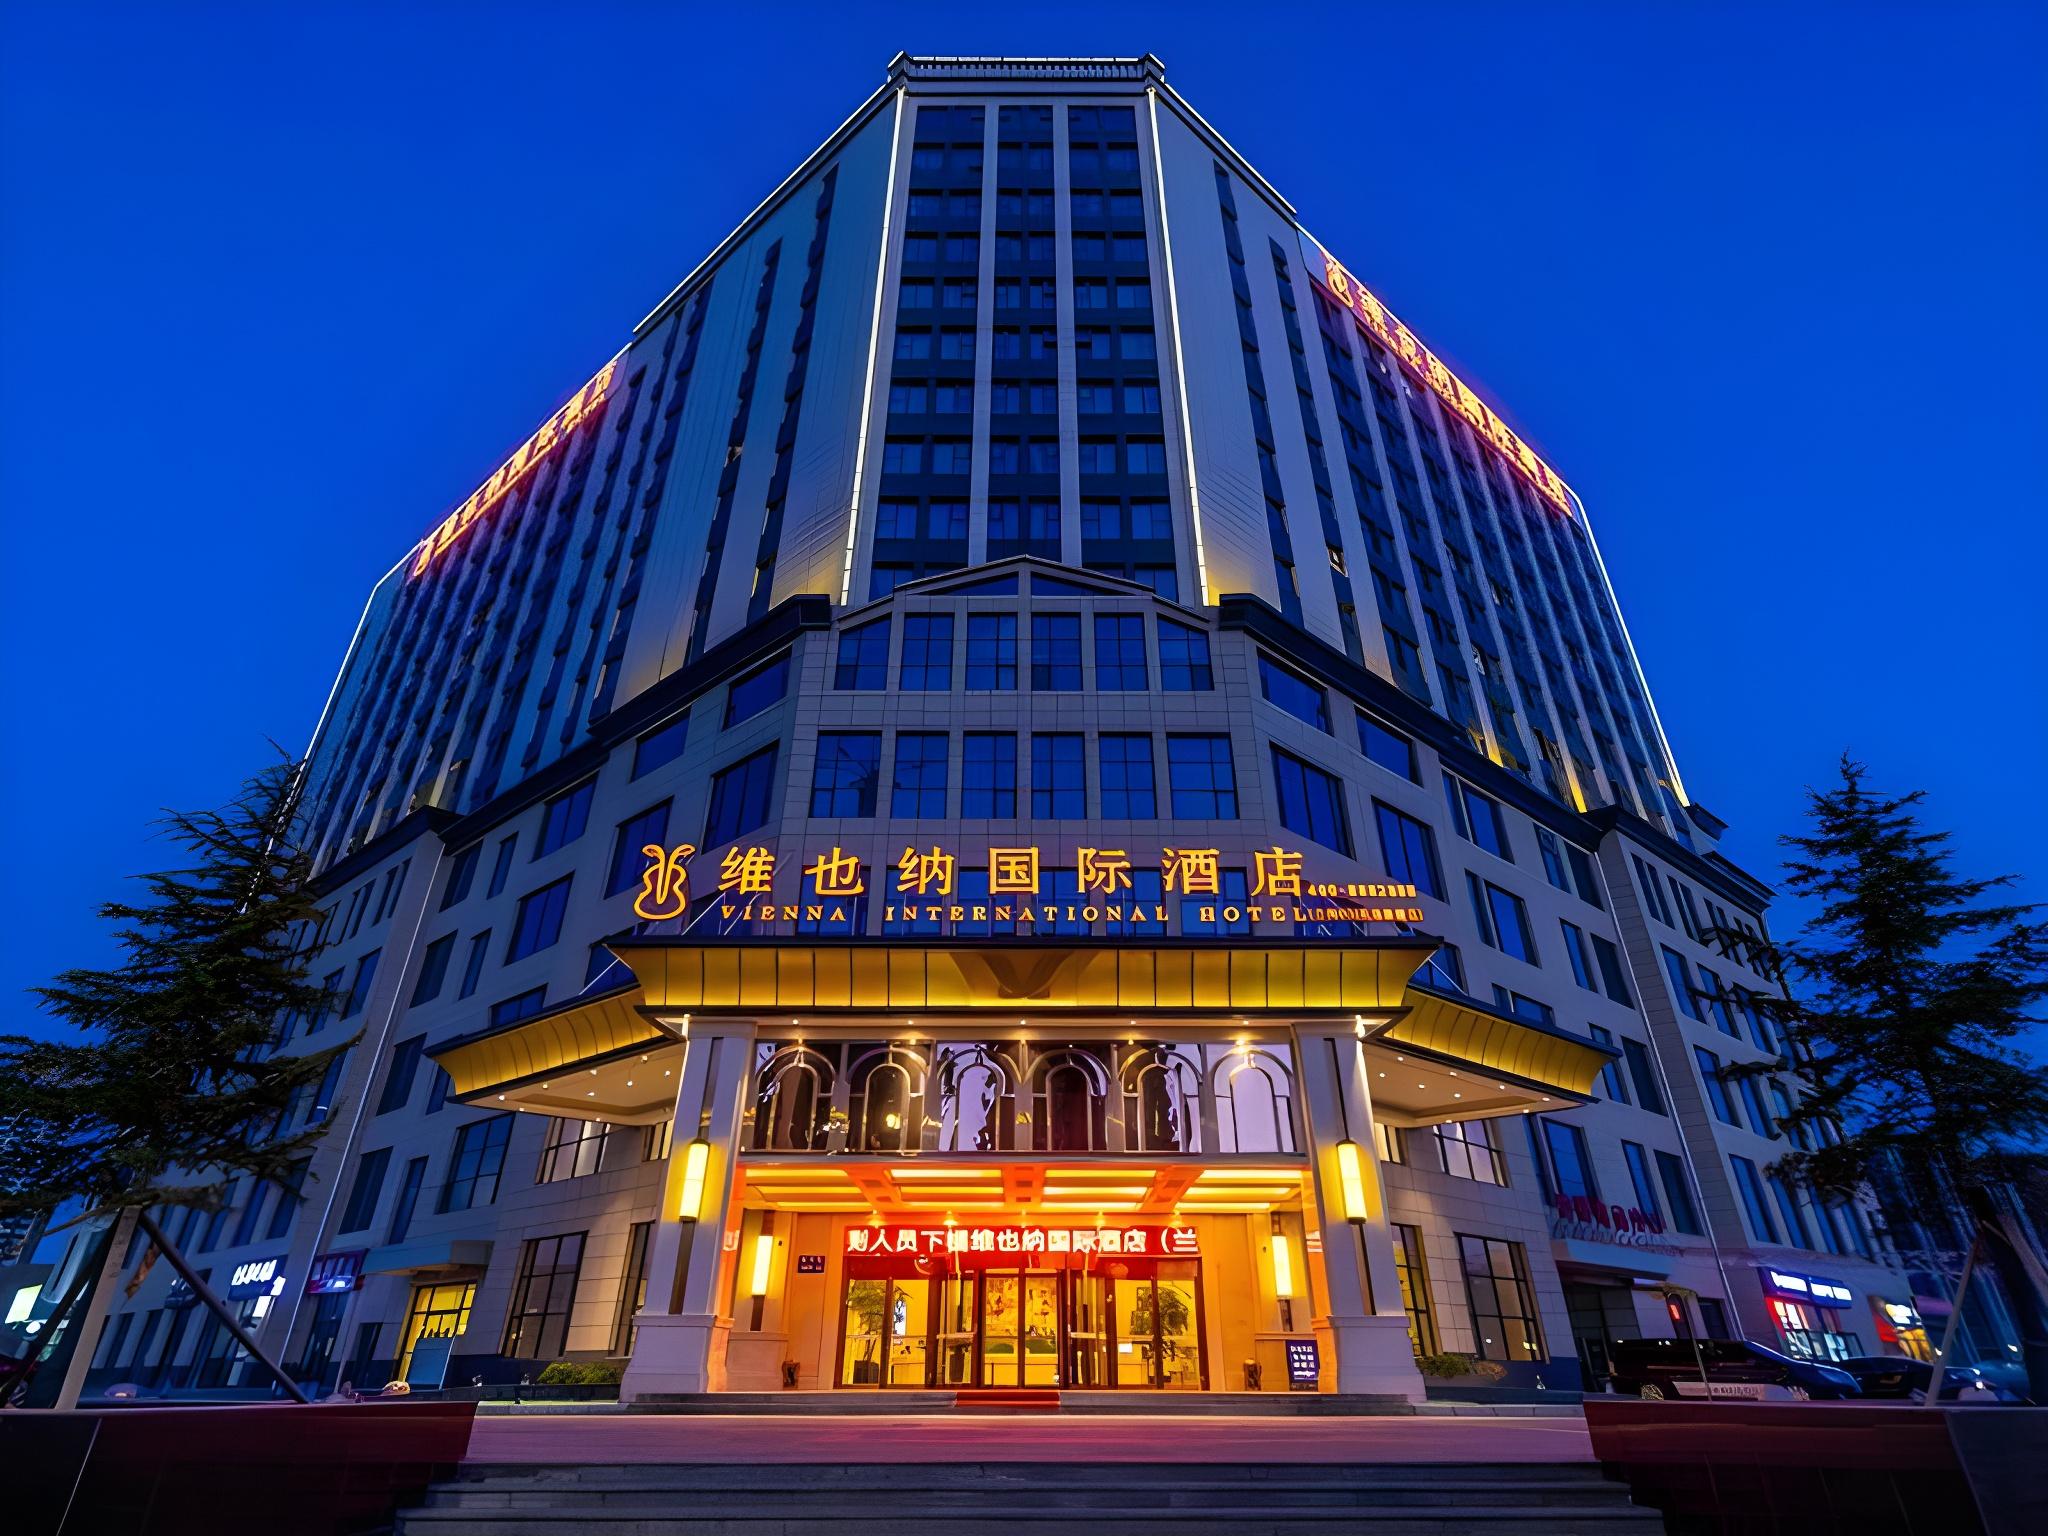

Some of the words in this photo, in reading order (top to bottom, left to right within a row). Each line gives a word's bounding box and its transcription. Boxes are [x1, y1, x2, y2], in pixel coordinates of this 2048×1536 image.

[717, 846, 1303, 897] 维也纳国际酒店
[721, 905, 847, 921] VIENNA
[885, 905, 1169, 922] INTERNATIONAL
[1199, 906, 1307, 922] HOTEL
